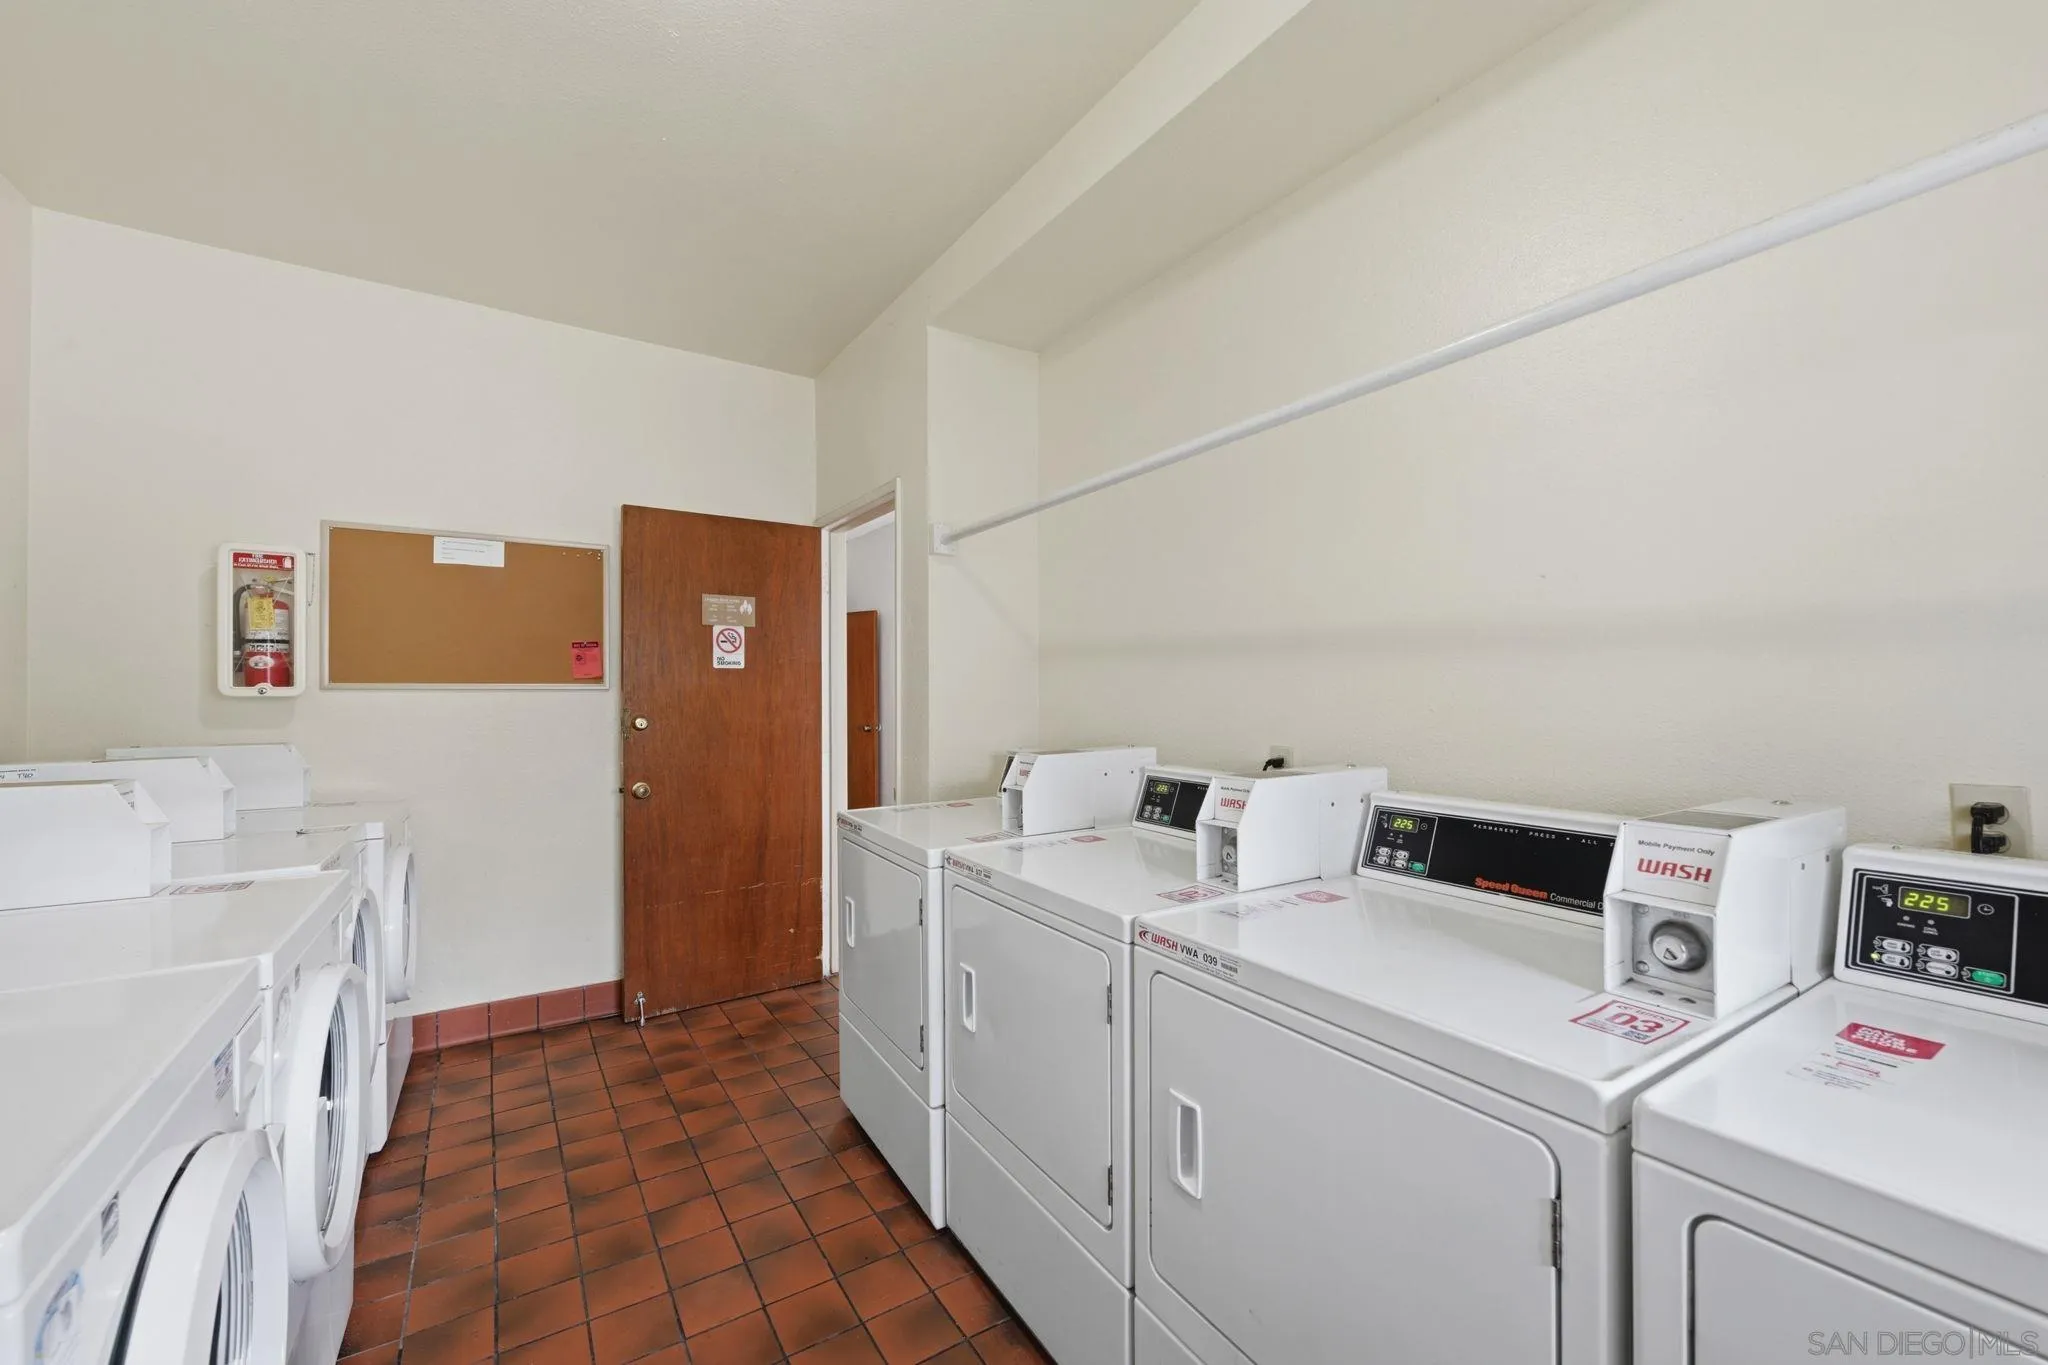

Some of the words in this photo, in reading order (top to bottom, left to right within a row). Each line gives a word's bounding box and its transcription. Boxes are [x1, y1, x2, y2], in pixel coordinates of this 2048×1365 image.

[1393, 818, 1414, 830] 225
[1473, 823, 1519, 835] PERMANENT
[1580, 838, 1598, 846] ALL
[1638, 839, 1661, 848] Mobile
[1662, 843, 1696, 853] Payment
[1696, 847, 1716, 857] Only
[1637, 857, 1713, 883] WASH
[1474, 877, 1510, 892] Speed
[1511, 883, 1549, 900] Queen
[1549, 892, 1596, 909] Commercial
[1903, 892, 1950, 912] 225
[1151, 932, 1178, 951] WASH
[1179, 943, 1199, 959] VWA
[1202, 953, 1218, 966] 039
[1605, 1013, 1664, 1033] 03
